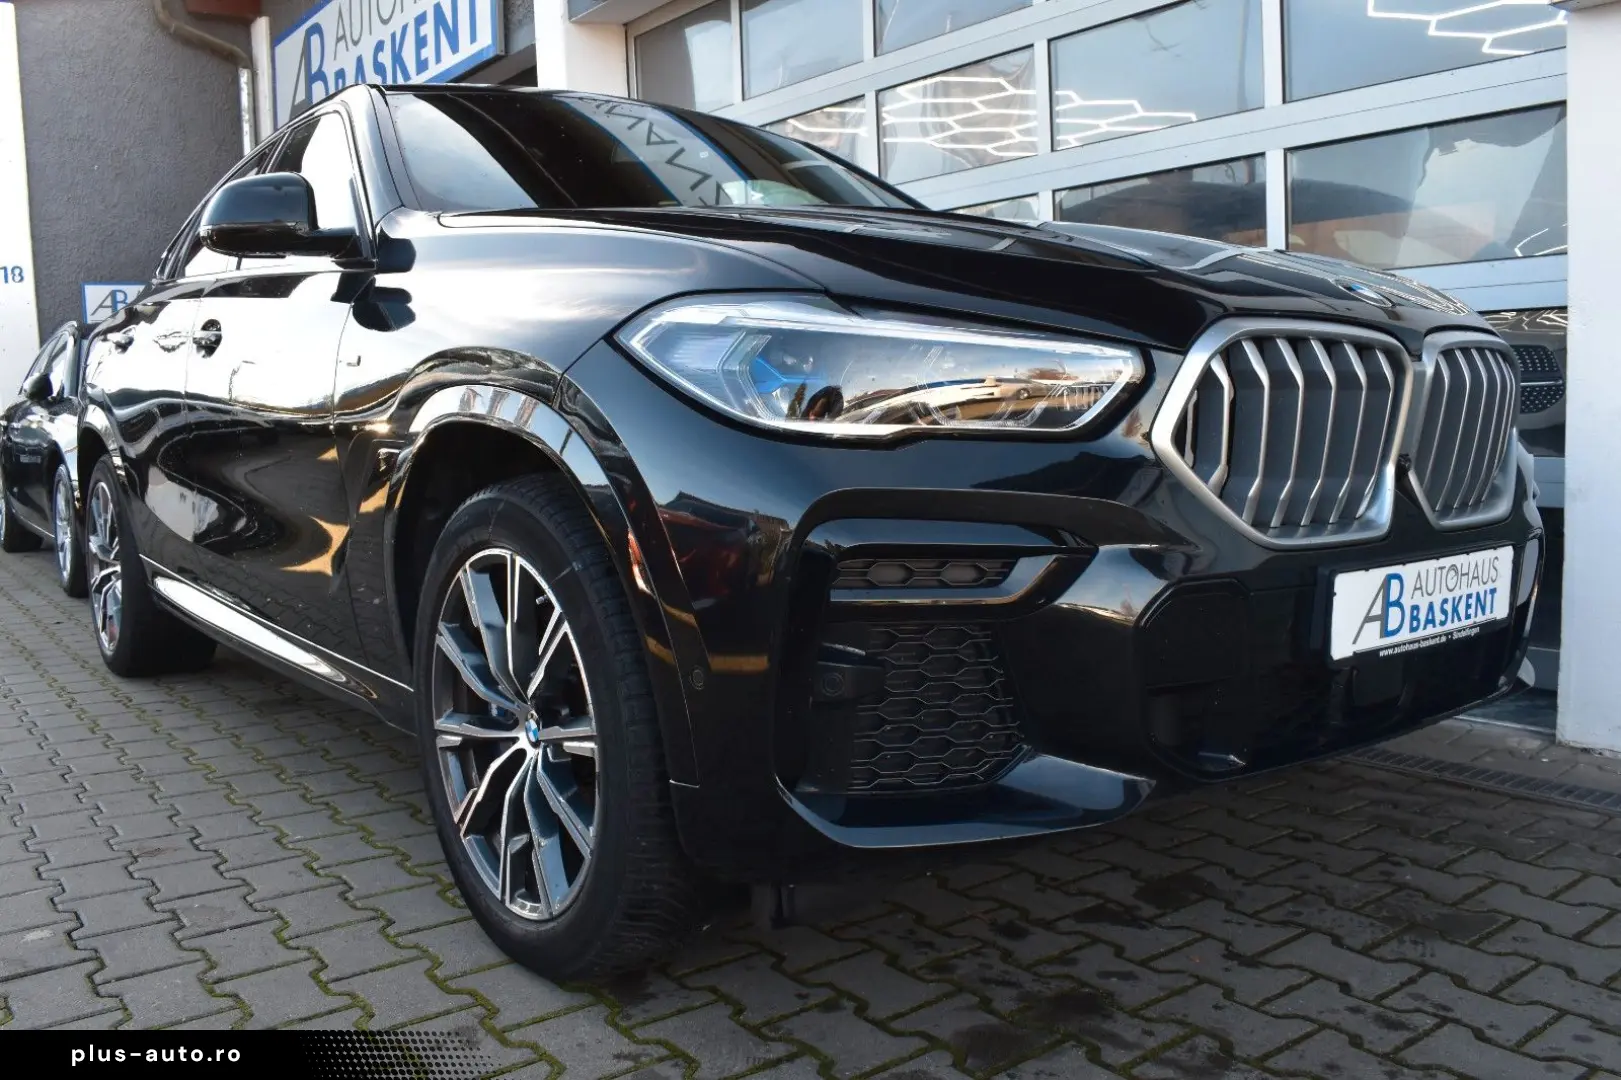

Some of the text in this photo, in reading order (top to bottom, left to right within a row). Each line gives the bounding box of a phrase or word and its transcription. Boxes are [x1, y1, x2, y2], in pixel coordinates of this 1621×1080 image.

[1411, 556, 1499, 599] AUTOHAUS
[1352, 573, 1406, 645] AB
[1409, 587, 1497, 633] BASKENT
